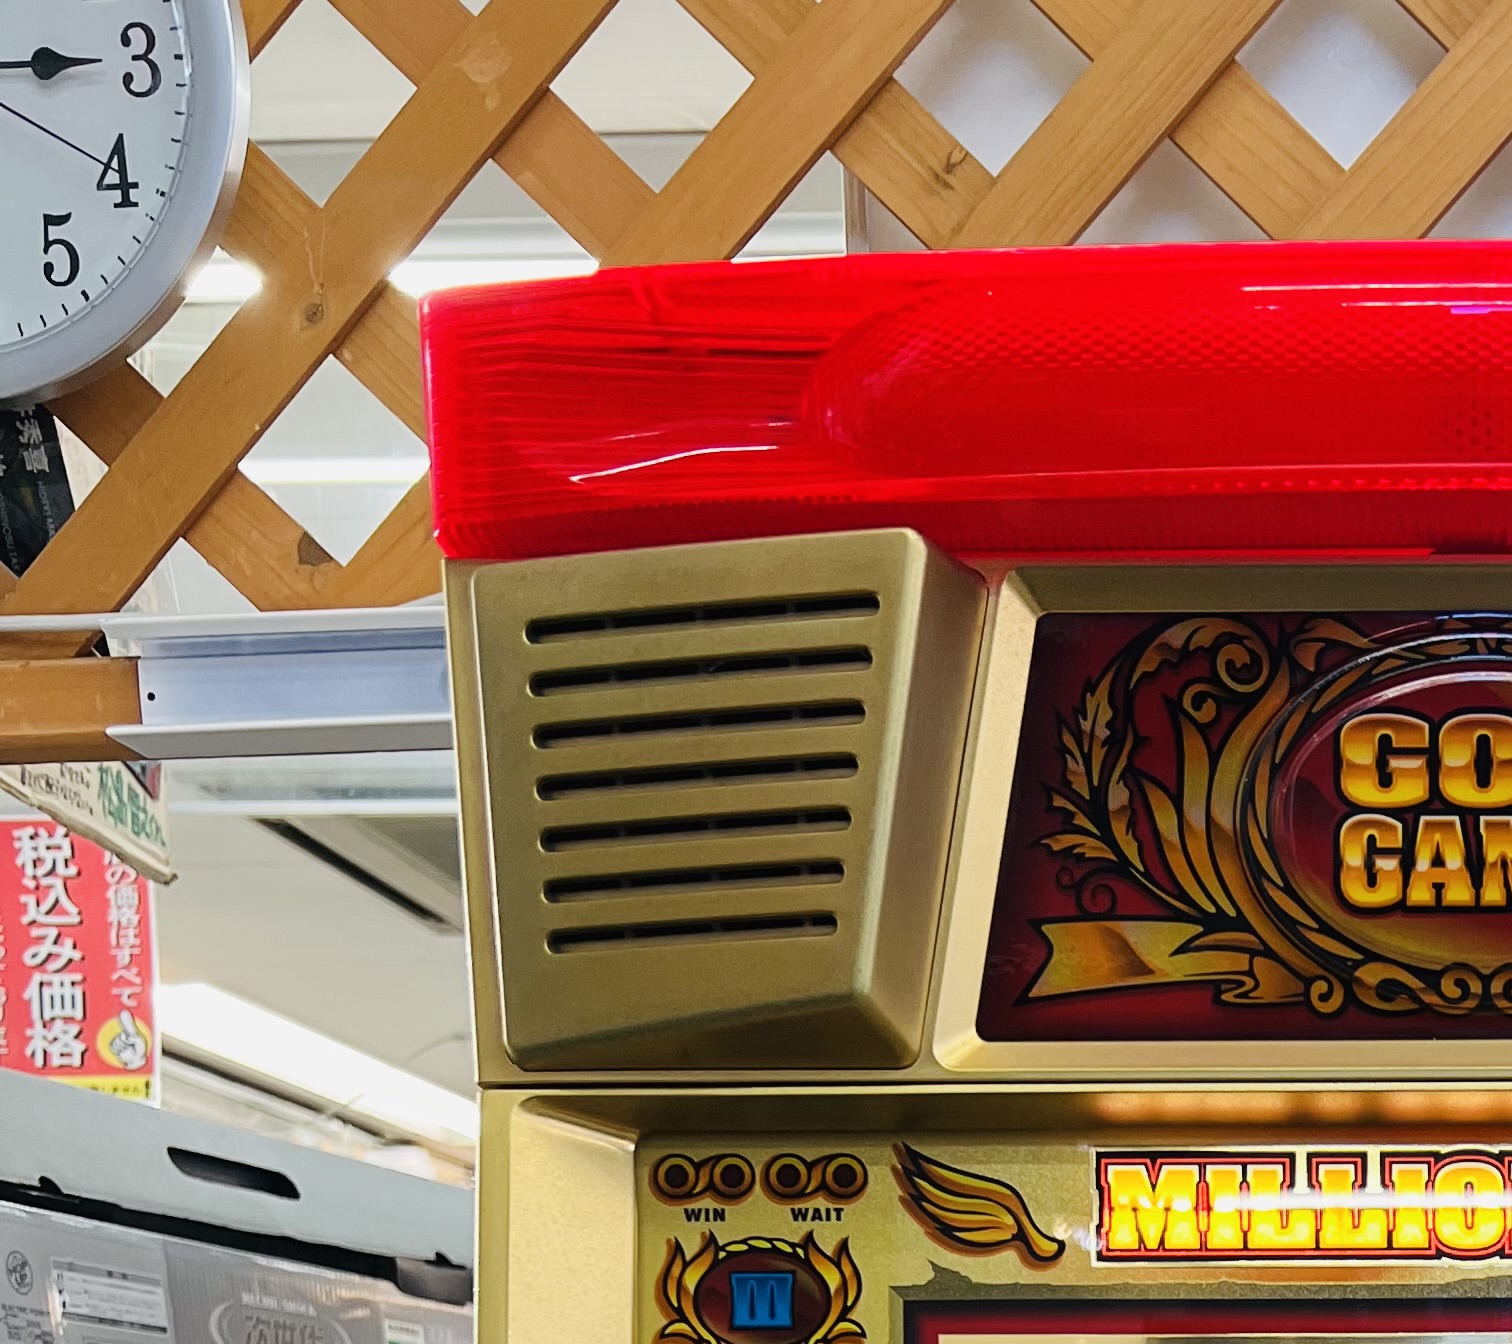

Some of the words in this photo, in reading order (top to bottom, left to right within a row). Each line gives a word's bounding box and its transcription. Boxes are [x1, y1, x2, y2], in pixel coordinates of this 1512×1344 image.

[120, 22, 161, 98] 3
[96, 133, 139, 209] 4
[43, 212, 80, 286] 5
[12, 826, 88, 1069] 税込み価格
[684, 1207, 726, 1222] WIN
[791, 1207, 844, 1222] WAIT
